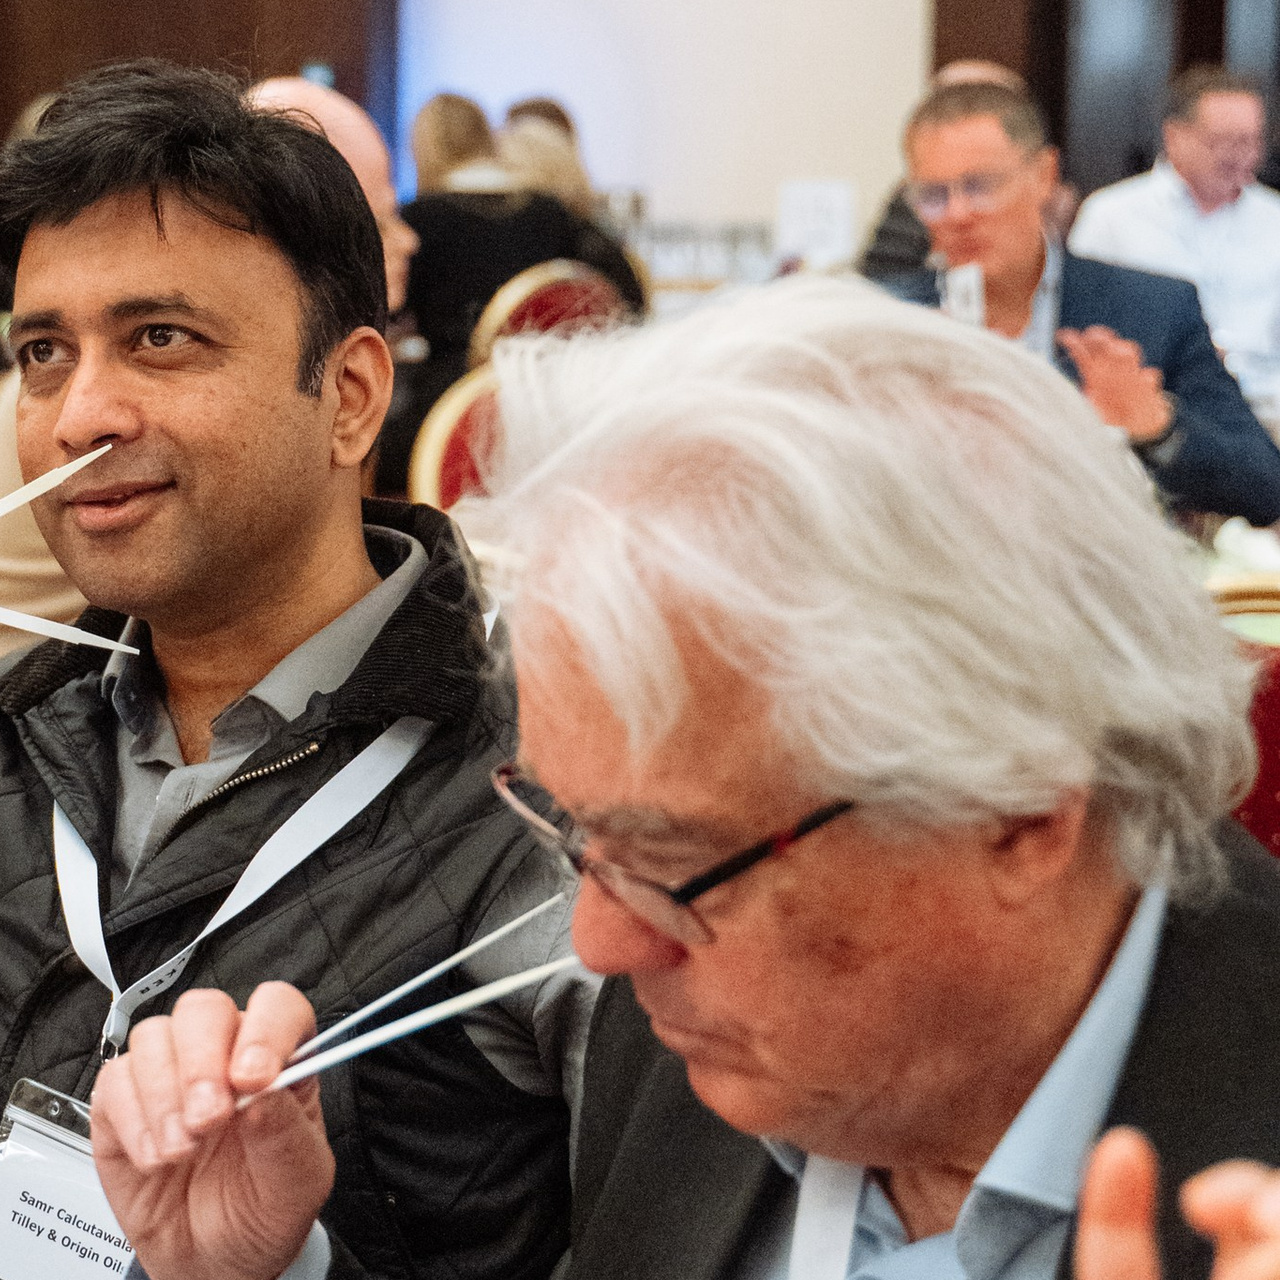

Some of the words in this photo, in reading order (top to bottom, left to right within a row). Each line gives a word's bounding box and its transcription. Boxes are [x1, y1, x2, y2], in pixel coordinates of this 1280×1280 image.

[11, 1210, 45, 1237] Tilley
[47, 1229, 57, 1242] &
[61, 1235, 100, 1263] Origin
[19, 1190, 55, 1214] Samr
[56, 1208, 133, 1253] Calcutawala
